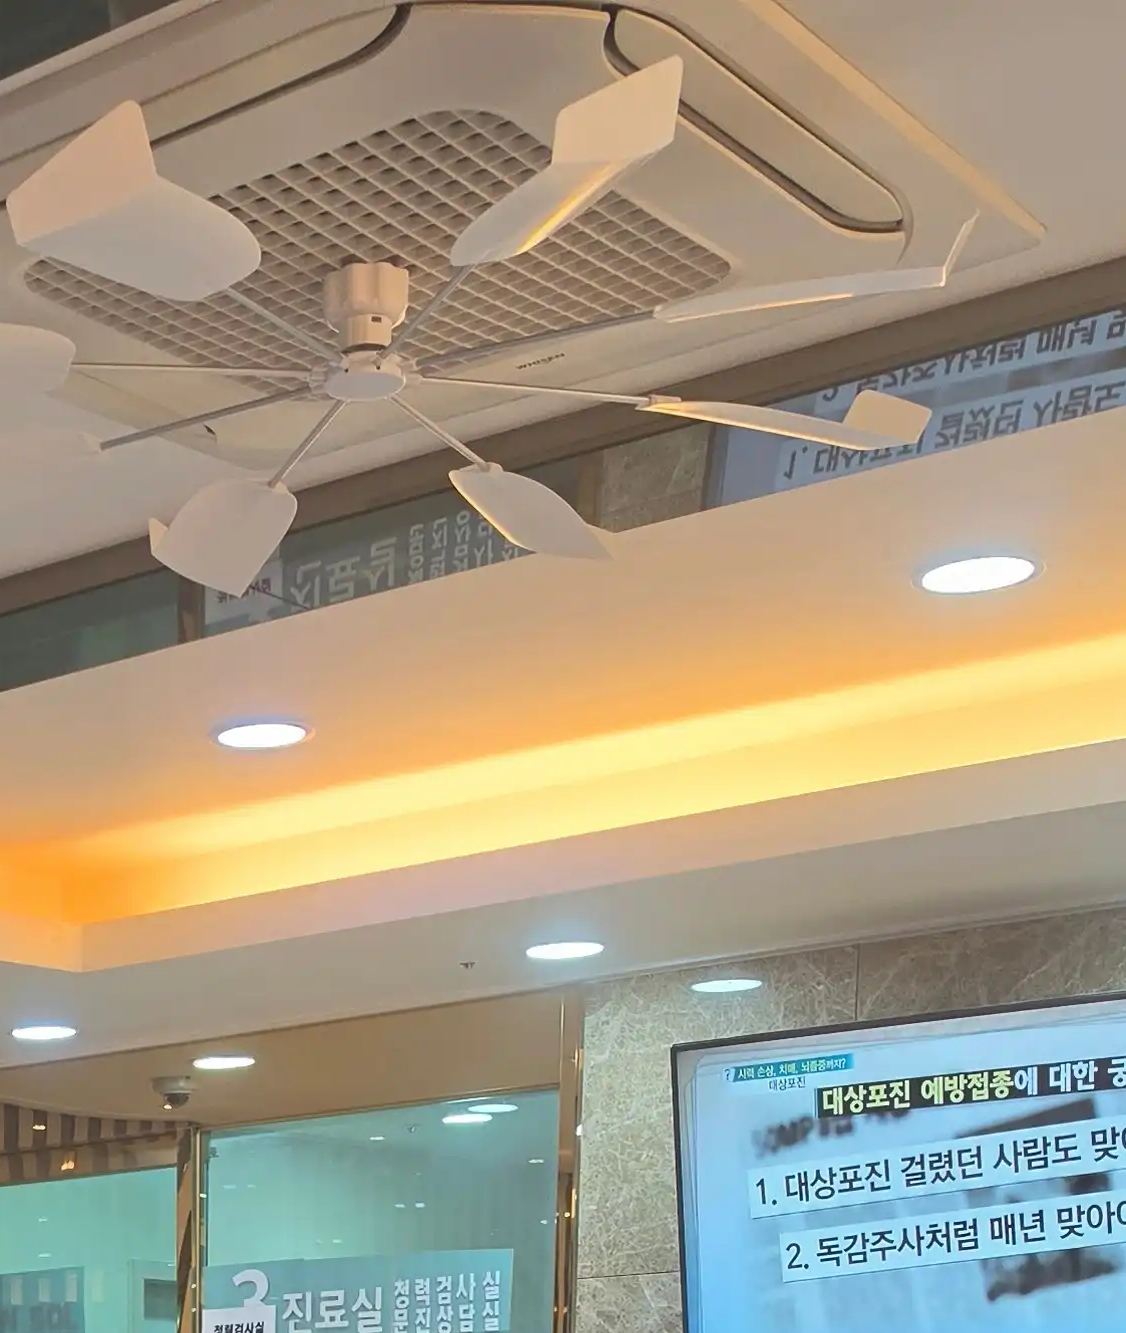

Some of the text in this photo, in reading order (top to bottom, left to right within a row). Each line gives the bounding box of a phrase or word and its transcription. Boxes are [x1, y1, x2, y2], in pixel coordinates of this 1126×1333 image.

[769, 1076, 806, 1090] 대상포진
[823, 1057, 1126, 1114] 대상포진 예방접종에 대한 궁
[755, 1178, 777, 1206] 1.
[785, 1159, 891, 1202] 대상포진
[900, 1148, 982, 1189] 걸렸던
[993, 1132, 1082, 1174] 사람도
[786, 1242, 809, 1271] 2.
[816, 1218, 979, 1269] 독감주사처럼
[990, 1209, 1045, 1246] 매년
